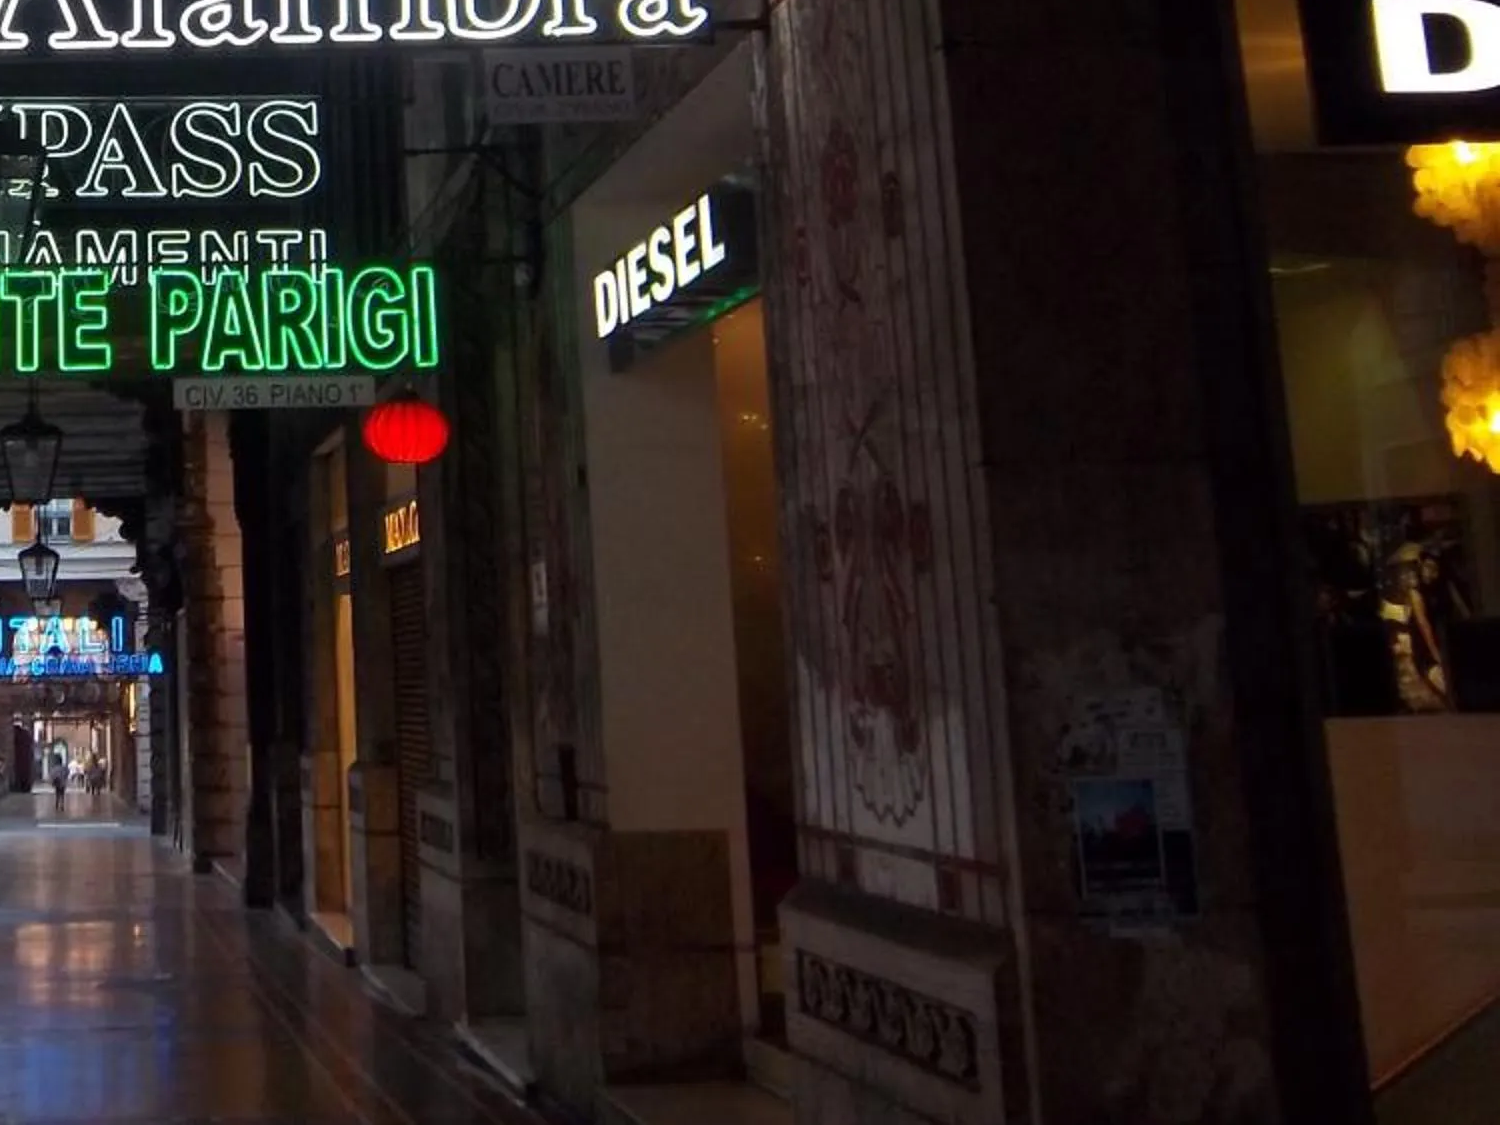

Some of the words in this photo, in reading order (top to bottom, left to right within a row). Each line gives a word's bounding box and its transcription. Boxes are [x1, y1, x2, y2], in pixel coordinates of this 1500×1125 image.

[492, 59, 626, 98] CAMERE
[593, 193, 726, 339] DIESEL
[148, 265, 442, 372] PARIGI
[233, 384, 259, 405] 36
[270, 382, 342, 404] PIANO
